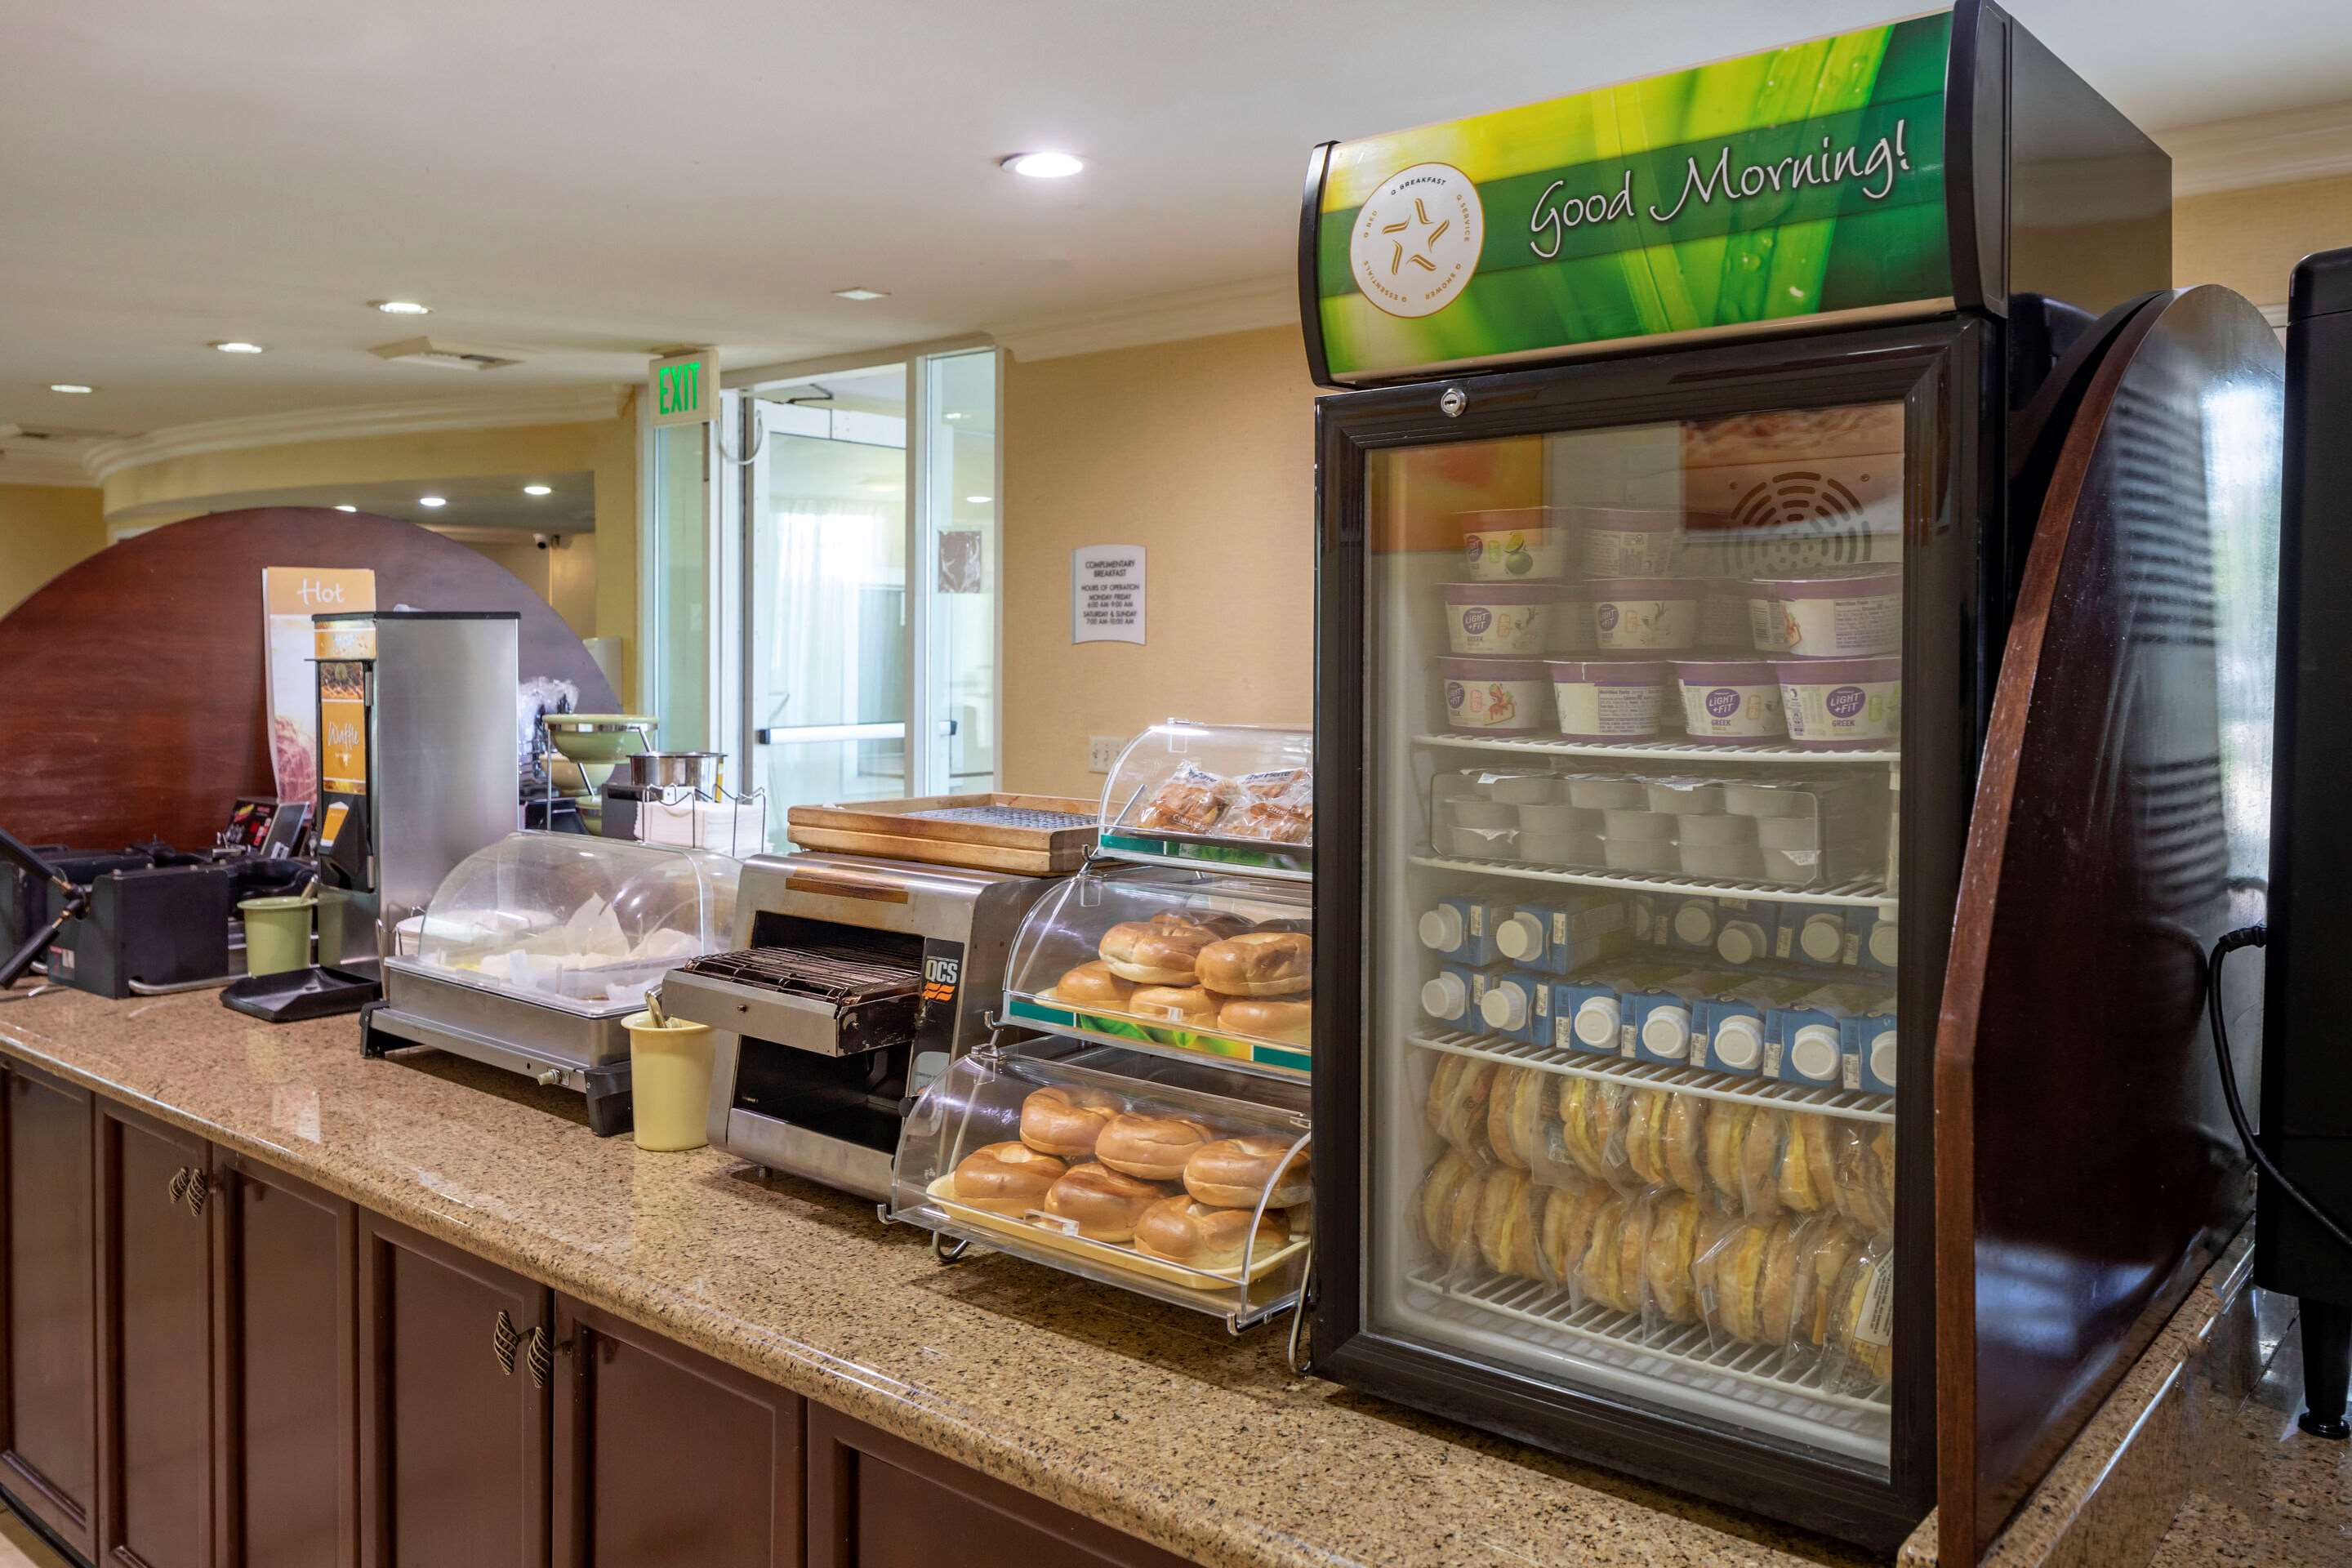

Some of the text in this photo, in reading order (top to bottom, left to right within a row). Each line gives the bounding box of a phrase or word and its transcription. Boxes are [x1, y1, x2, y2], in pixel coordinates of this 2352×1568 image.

[1399, 177, 1446, 190] BREAKFAST
[1530, 119, 1910, 258] Good Morning!
[1459, 203, 1470, 242] SERVICE
[1363, 261, 1399, 301] ESSENTIALS
[1425, 272, 1456, 300] SHOWER
[659, 362, 700, 415] EXIT
[1094, 569, 1126, 577] BREAKFAST
[296, 577, 345, 606] Hot
[924, 959, 958, 984] QCS
